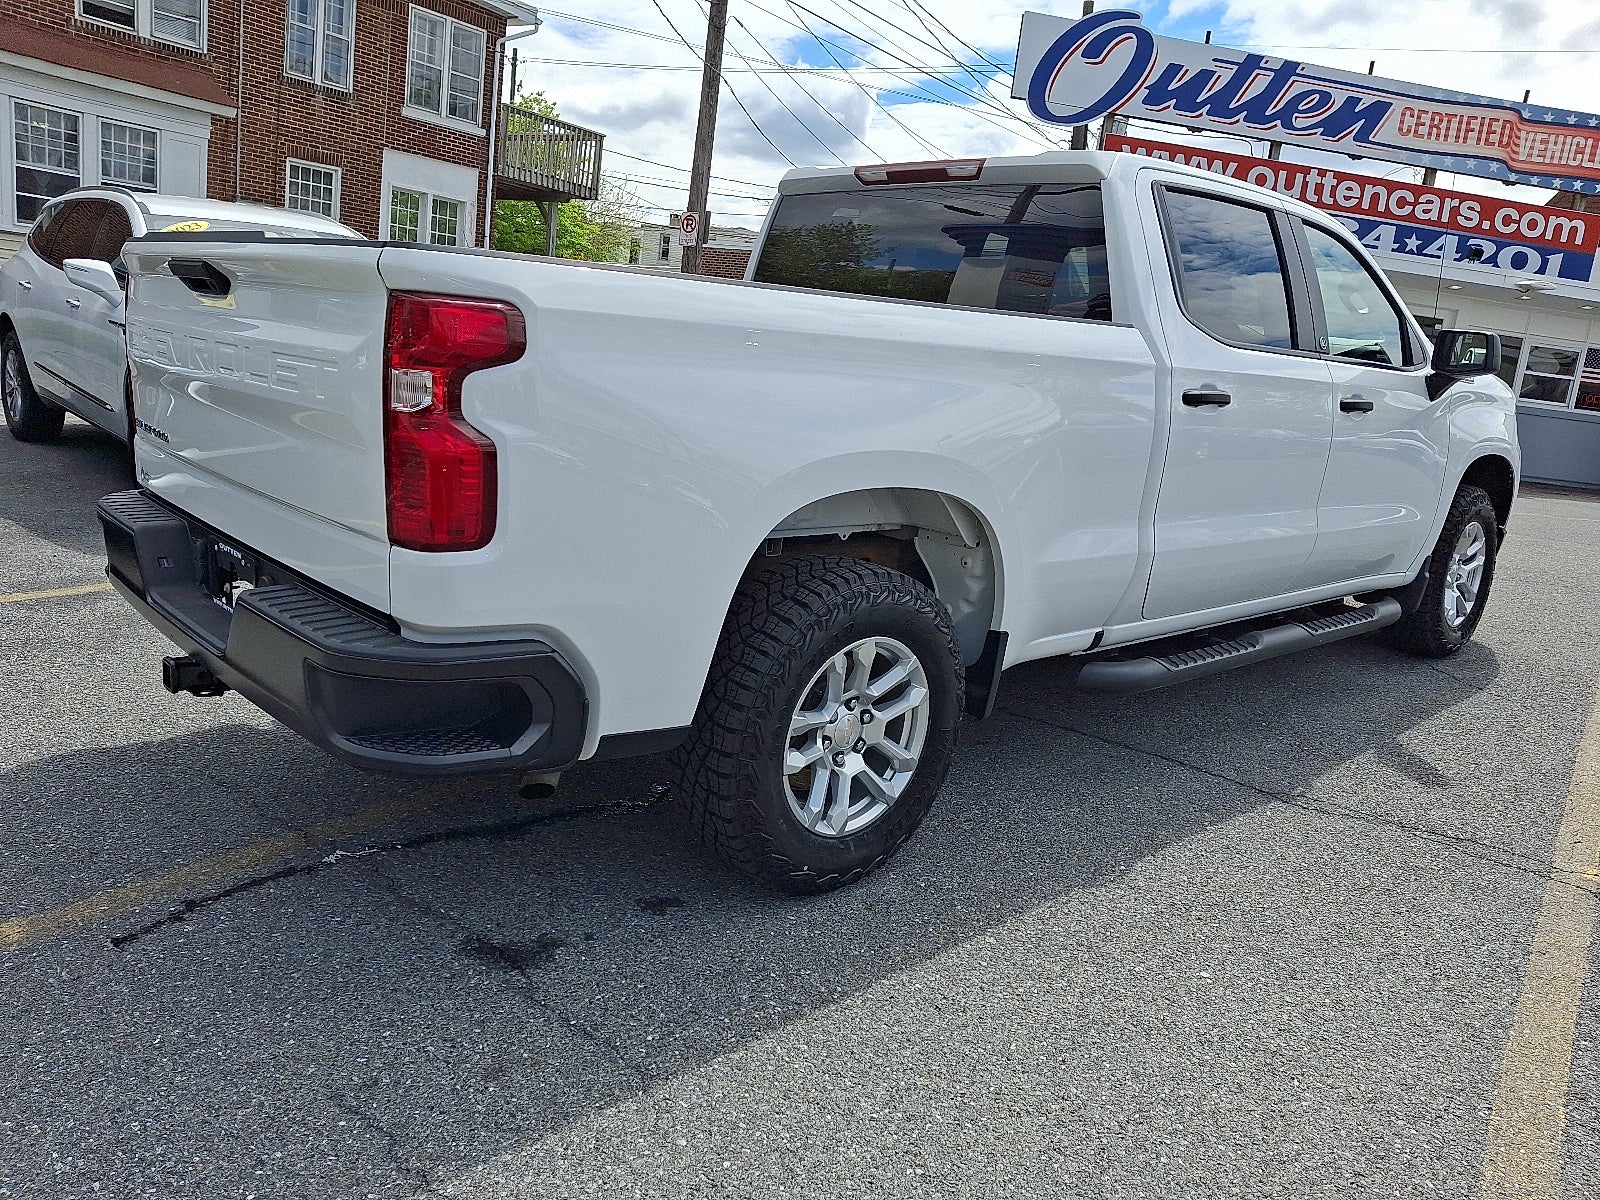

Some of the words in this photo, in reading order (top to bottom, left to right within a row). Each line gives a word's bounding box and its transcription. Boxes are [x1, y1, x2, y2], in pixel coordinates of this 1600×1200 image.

[1027, 10, 1394, 142] Outten
[1397, 106, 1516, 150] CERTIFIED
[1121, 144, 1587, 246] wouttencars.com
